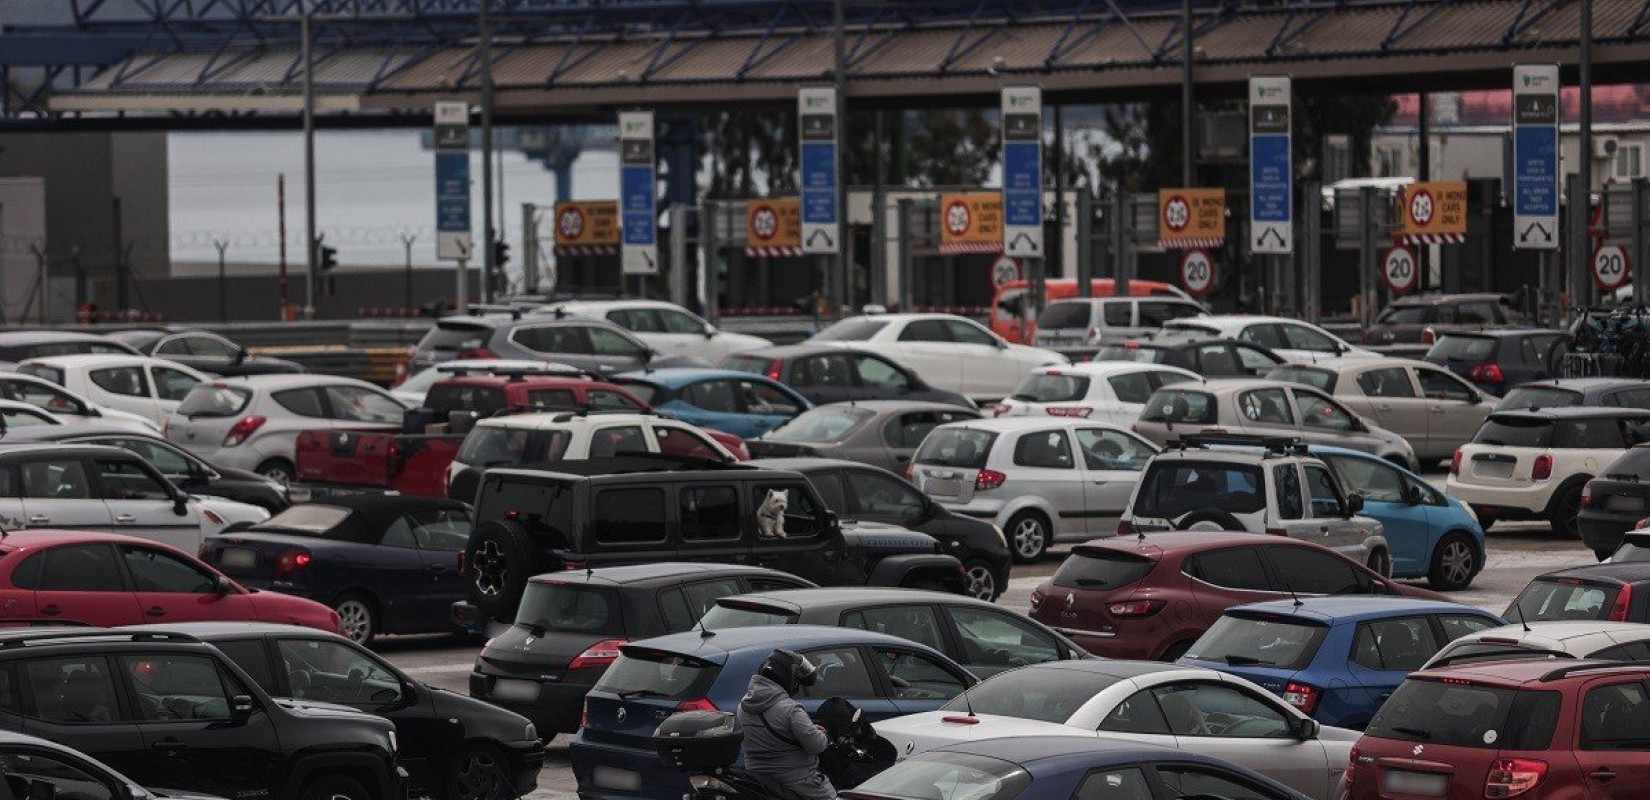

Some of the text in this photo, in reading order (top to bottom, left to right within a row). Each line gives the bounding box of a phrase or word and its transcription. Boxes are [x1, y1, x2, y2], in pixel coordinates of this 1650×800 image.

[997, 264, 1016, 284] 20
[1187, 261, 1207, 281] 20
[1389, 257, 1410, 278] 20
[1599, 254, 1622, 275] 20
[867, 539, 931, 548] RUBICON
